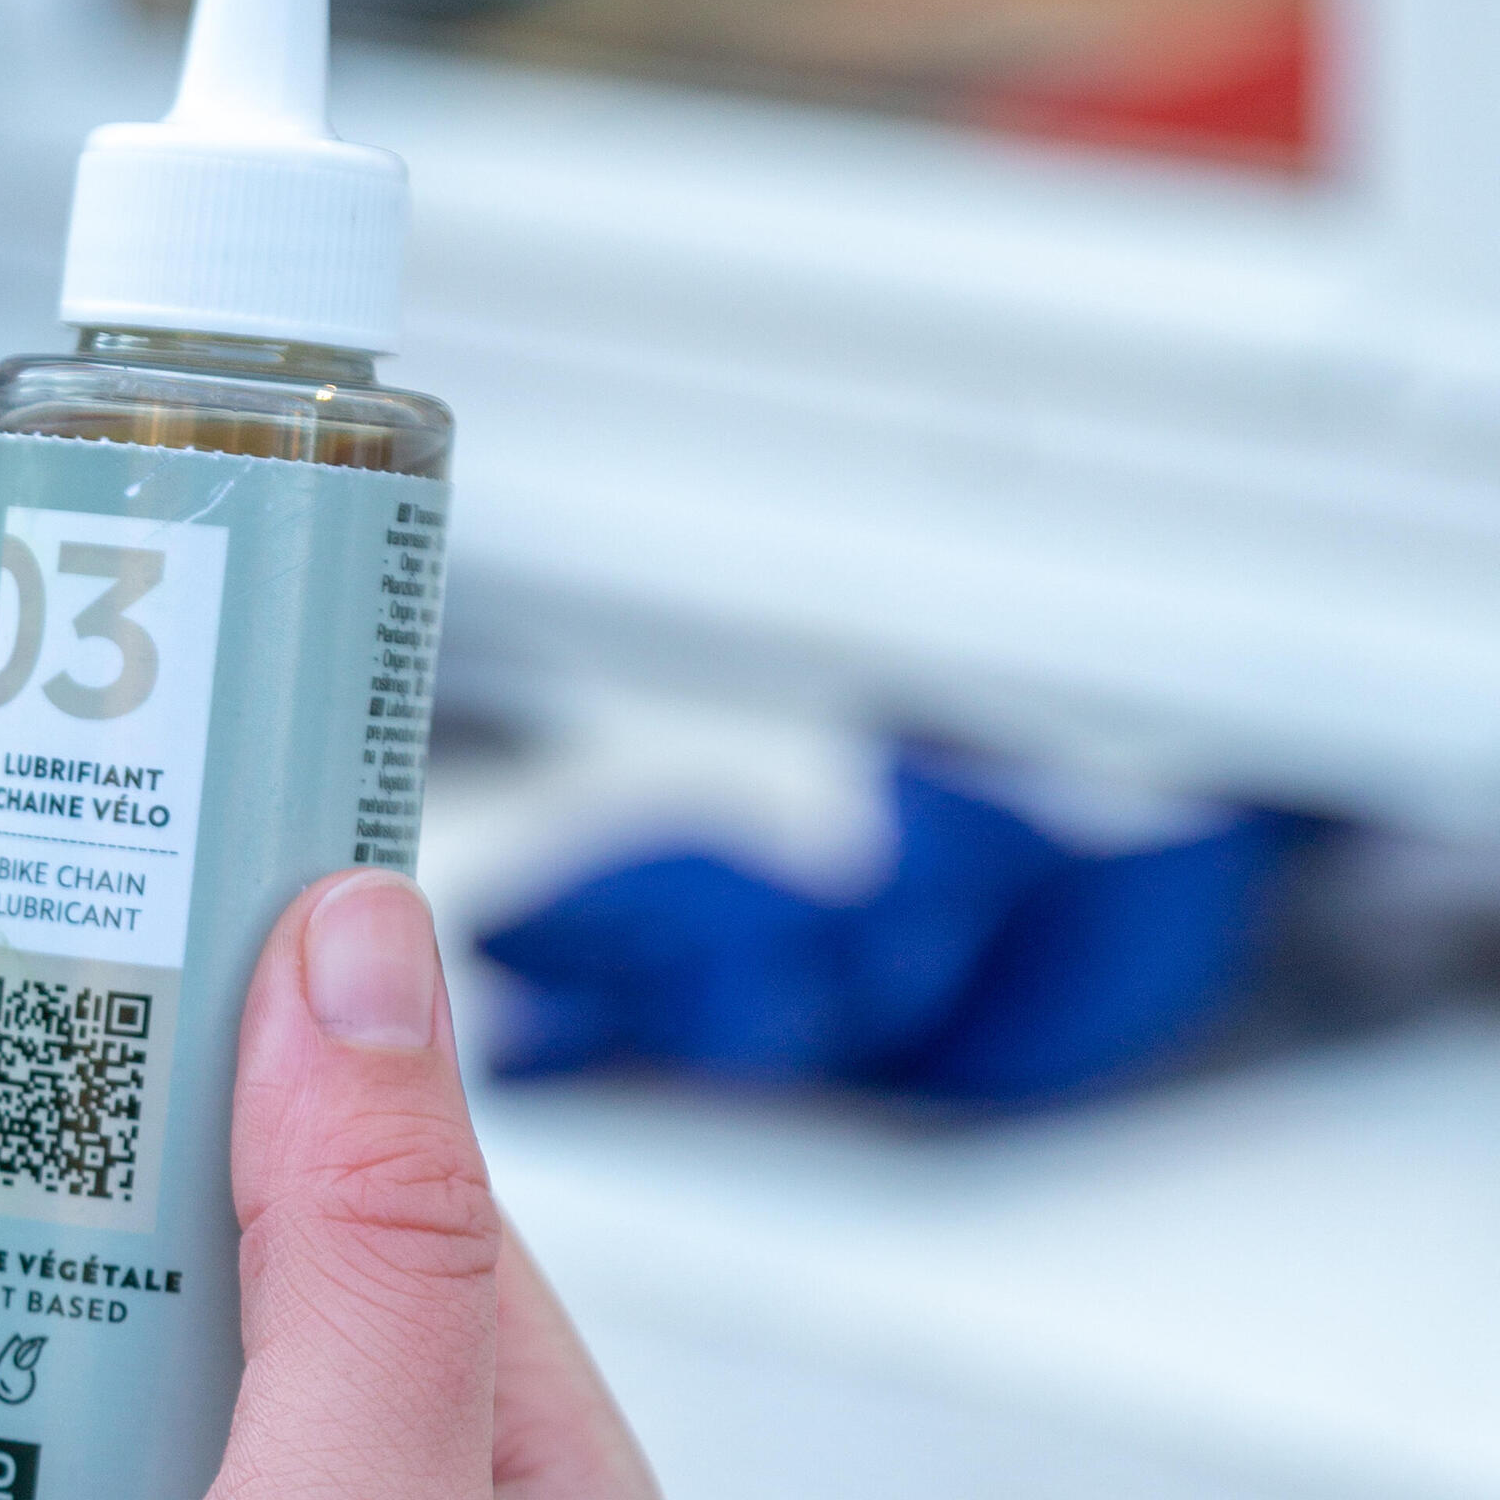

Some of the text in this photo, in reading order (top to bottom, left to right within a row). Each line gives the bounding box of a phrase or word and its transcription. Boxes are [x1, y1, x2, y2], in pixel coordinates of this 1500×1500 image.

[4, 752, 164, 791] LUBRIFIANT
[92, 793, 171, 828] VÉLO
[56, 864, 146, 896] CHAIN
[18, 1248, 183, 1294] VÉGÉTALE
[26, 1289, 129, 1324] BASED
